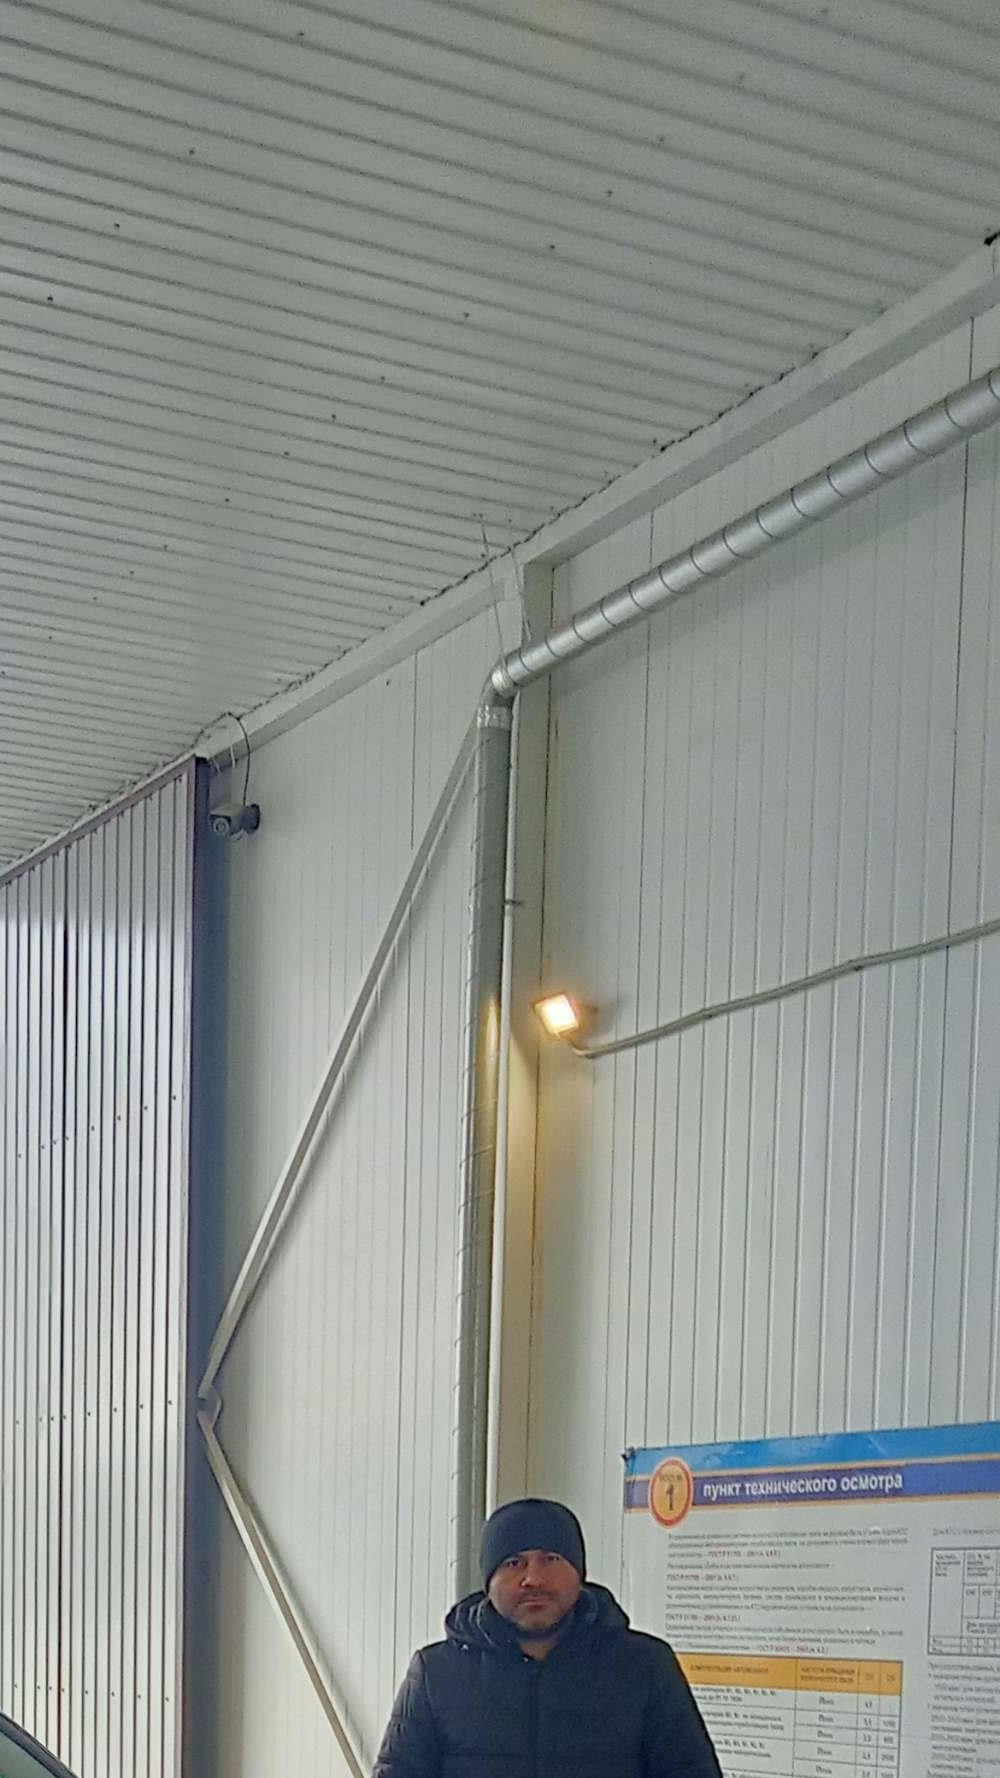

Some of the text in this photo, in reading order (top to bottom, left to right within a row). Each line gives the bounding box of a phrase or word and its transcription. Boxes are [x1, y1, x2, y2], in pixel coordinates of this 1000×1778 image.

[703, 1471, 903, 1503] пункт технического осмотра
